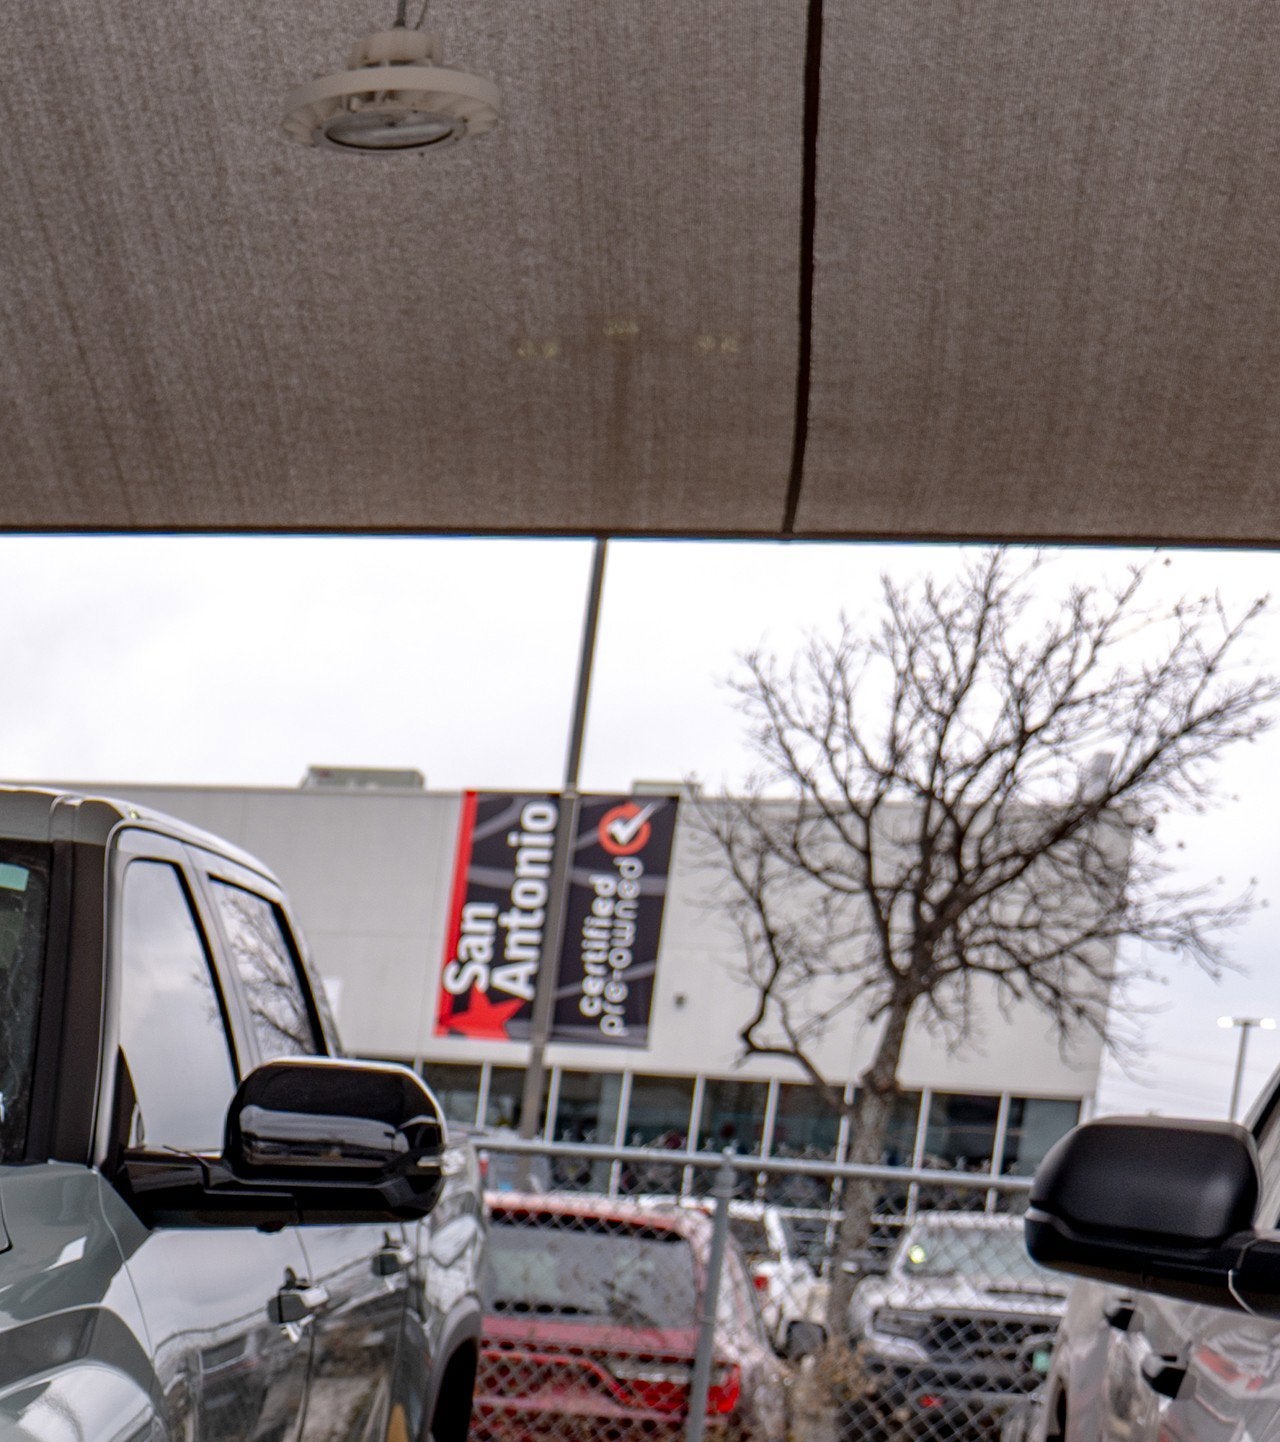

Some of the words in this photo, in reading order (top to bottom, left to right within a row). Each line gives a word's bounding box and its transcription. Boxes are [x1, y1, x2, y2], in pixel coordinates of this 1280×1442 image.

[443, 902, 497, 993] San
[491, 801, 558, 1001] Antonio
[579, 875, 618, 1017] certified
[600, 856, 644, 1036] pre-owned
